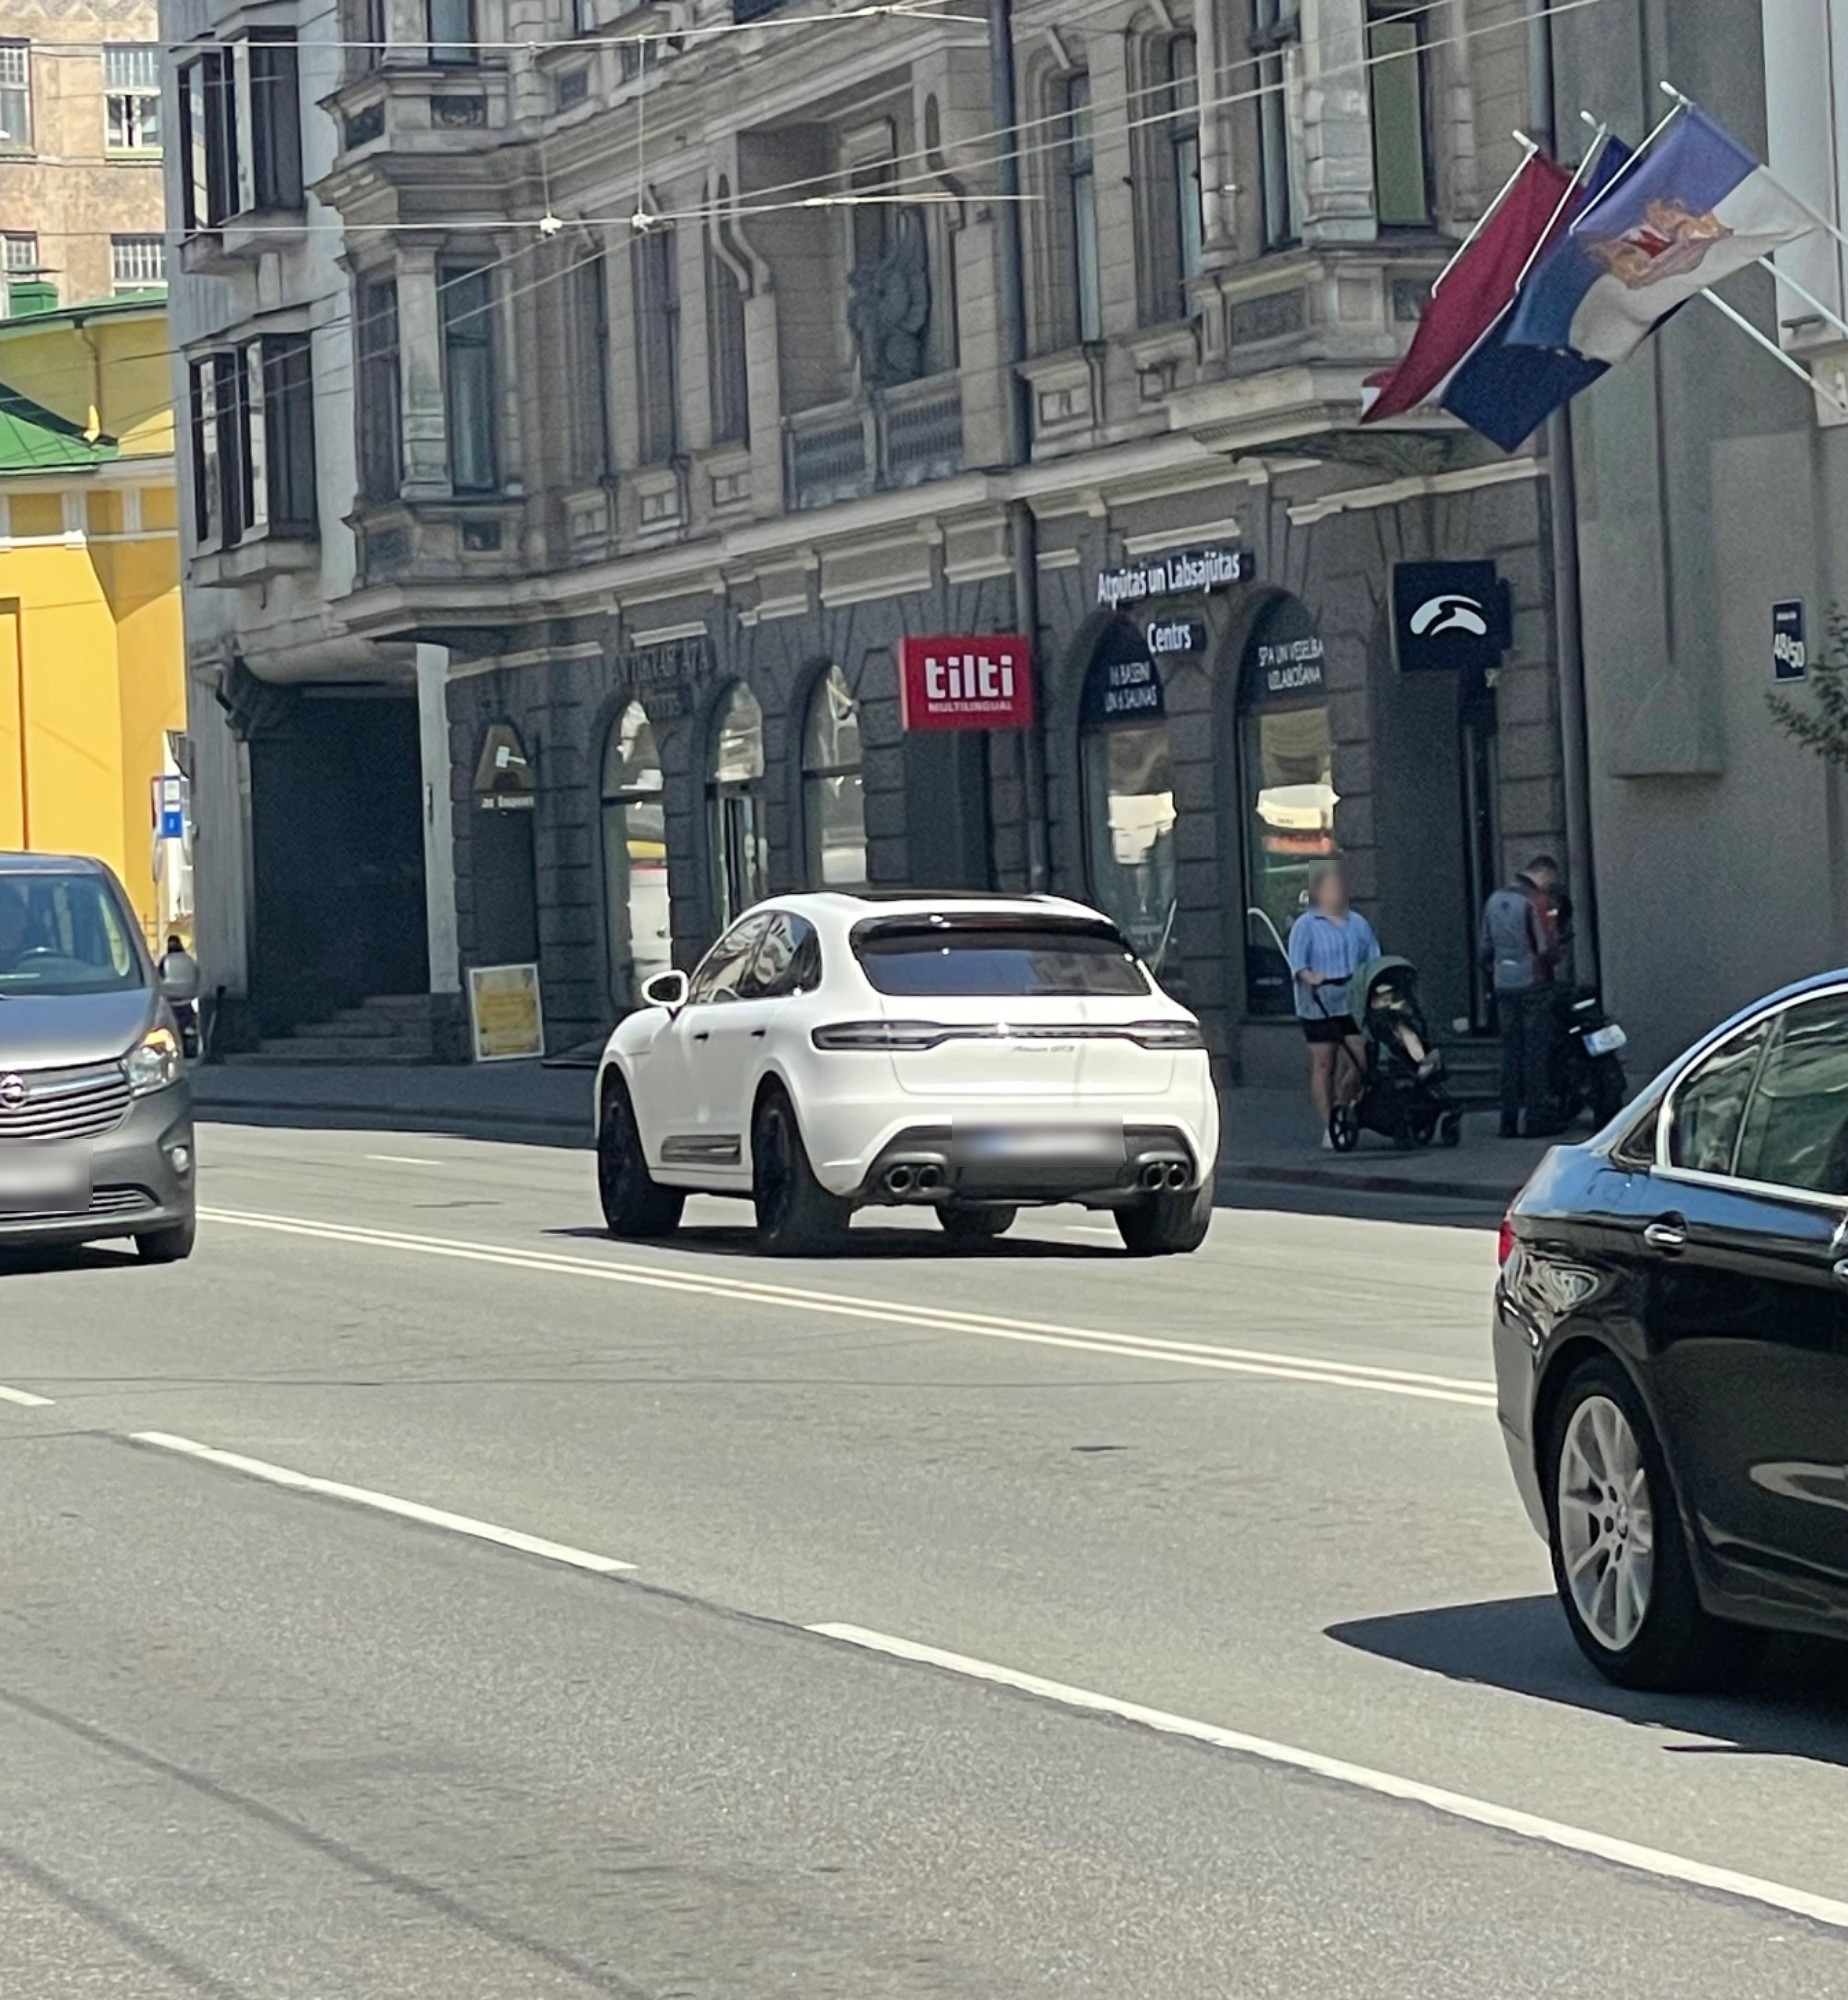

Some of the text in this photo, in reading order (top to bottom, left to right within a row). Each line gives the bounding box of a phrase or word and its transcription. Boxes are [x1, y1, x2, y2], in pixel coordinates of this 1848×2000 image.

[1149, 567, 1166, 594] un
[1167, 551, 1240, 594] Labsajūtas
[1147, 622, 1192, 653] Centrs
[925, 654, 1014, 699] tilti
[928, 701, 1013, 712] MULTILINGUAL
